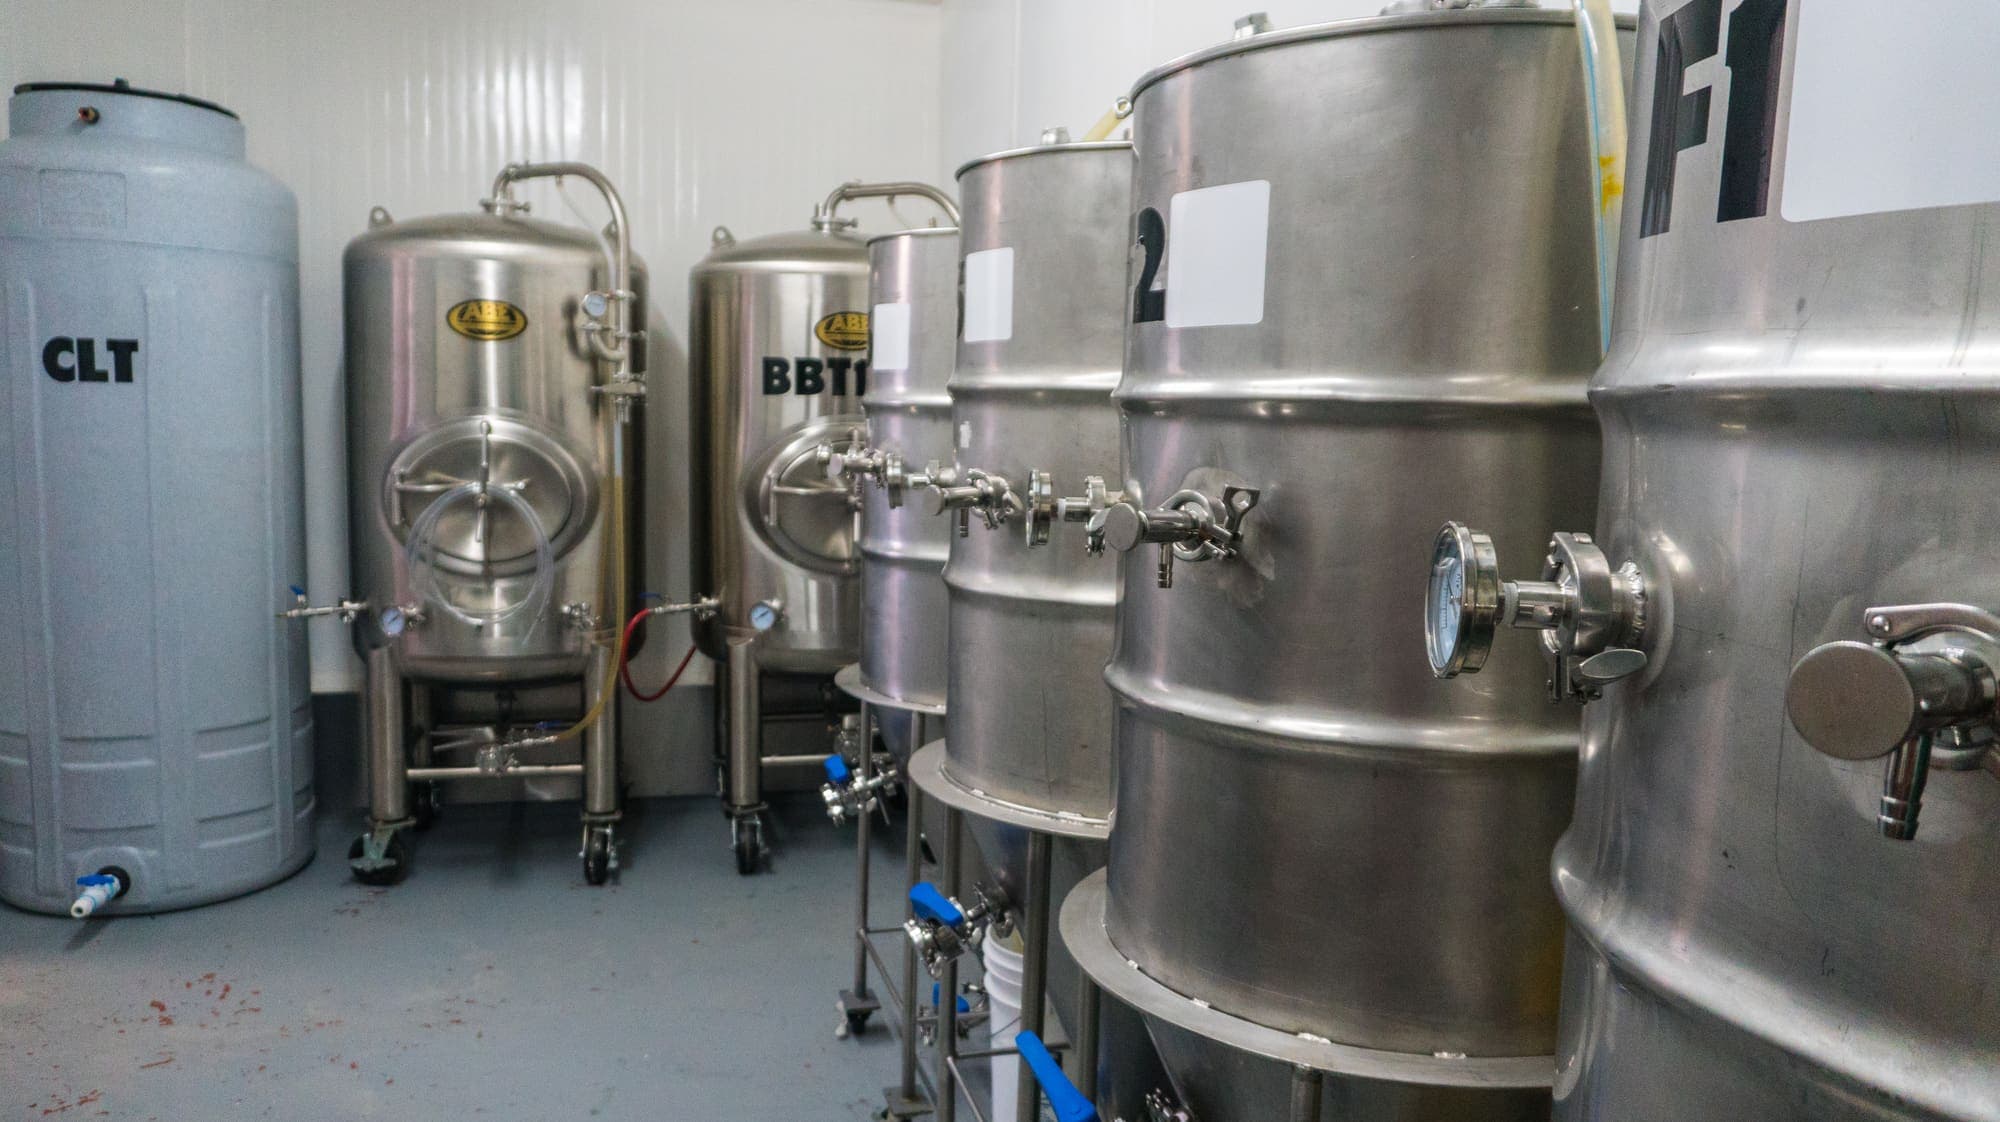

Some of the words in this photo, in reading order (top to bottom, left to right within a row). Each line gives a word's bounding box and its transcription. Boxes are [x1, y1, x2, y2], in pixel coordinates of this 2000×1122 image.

[1640, 0, 1787, 239] F1
[1132, 206, 1166, 324] 2
[42, 336, 139, 383] CLT
